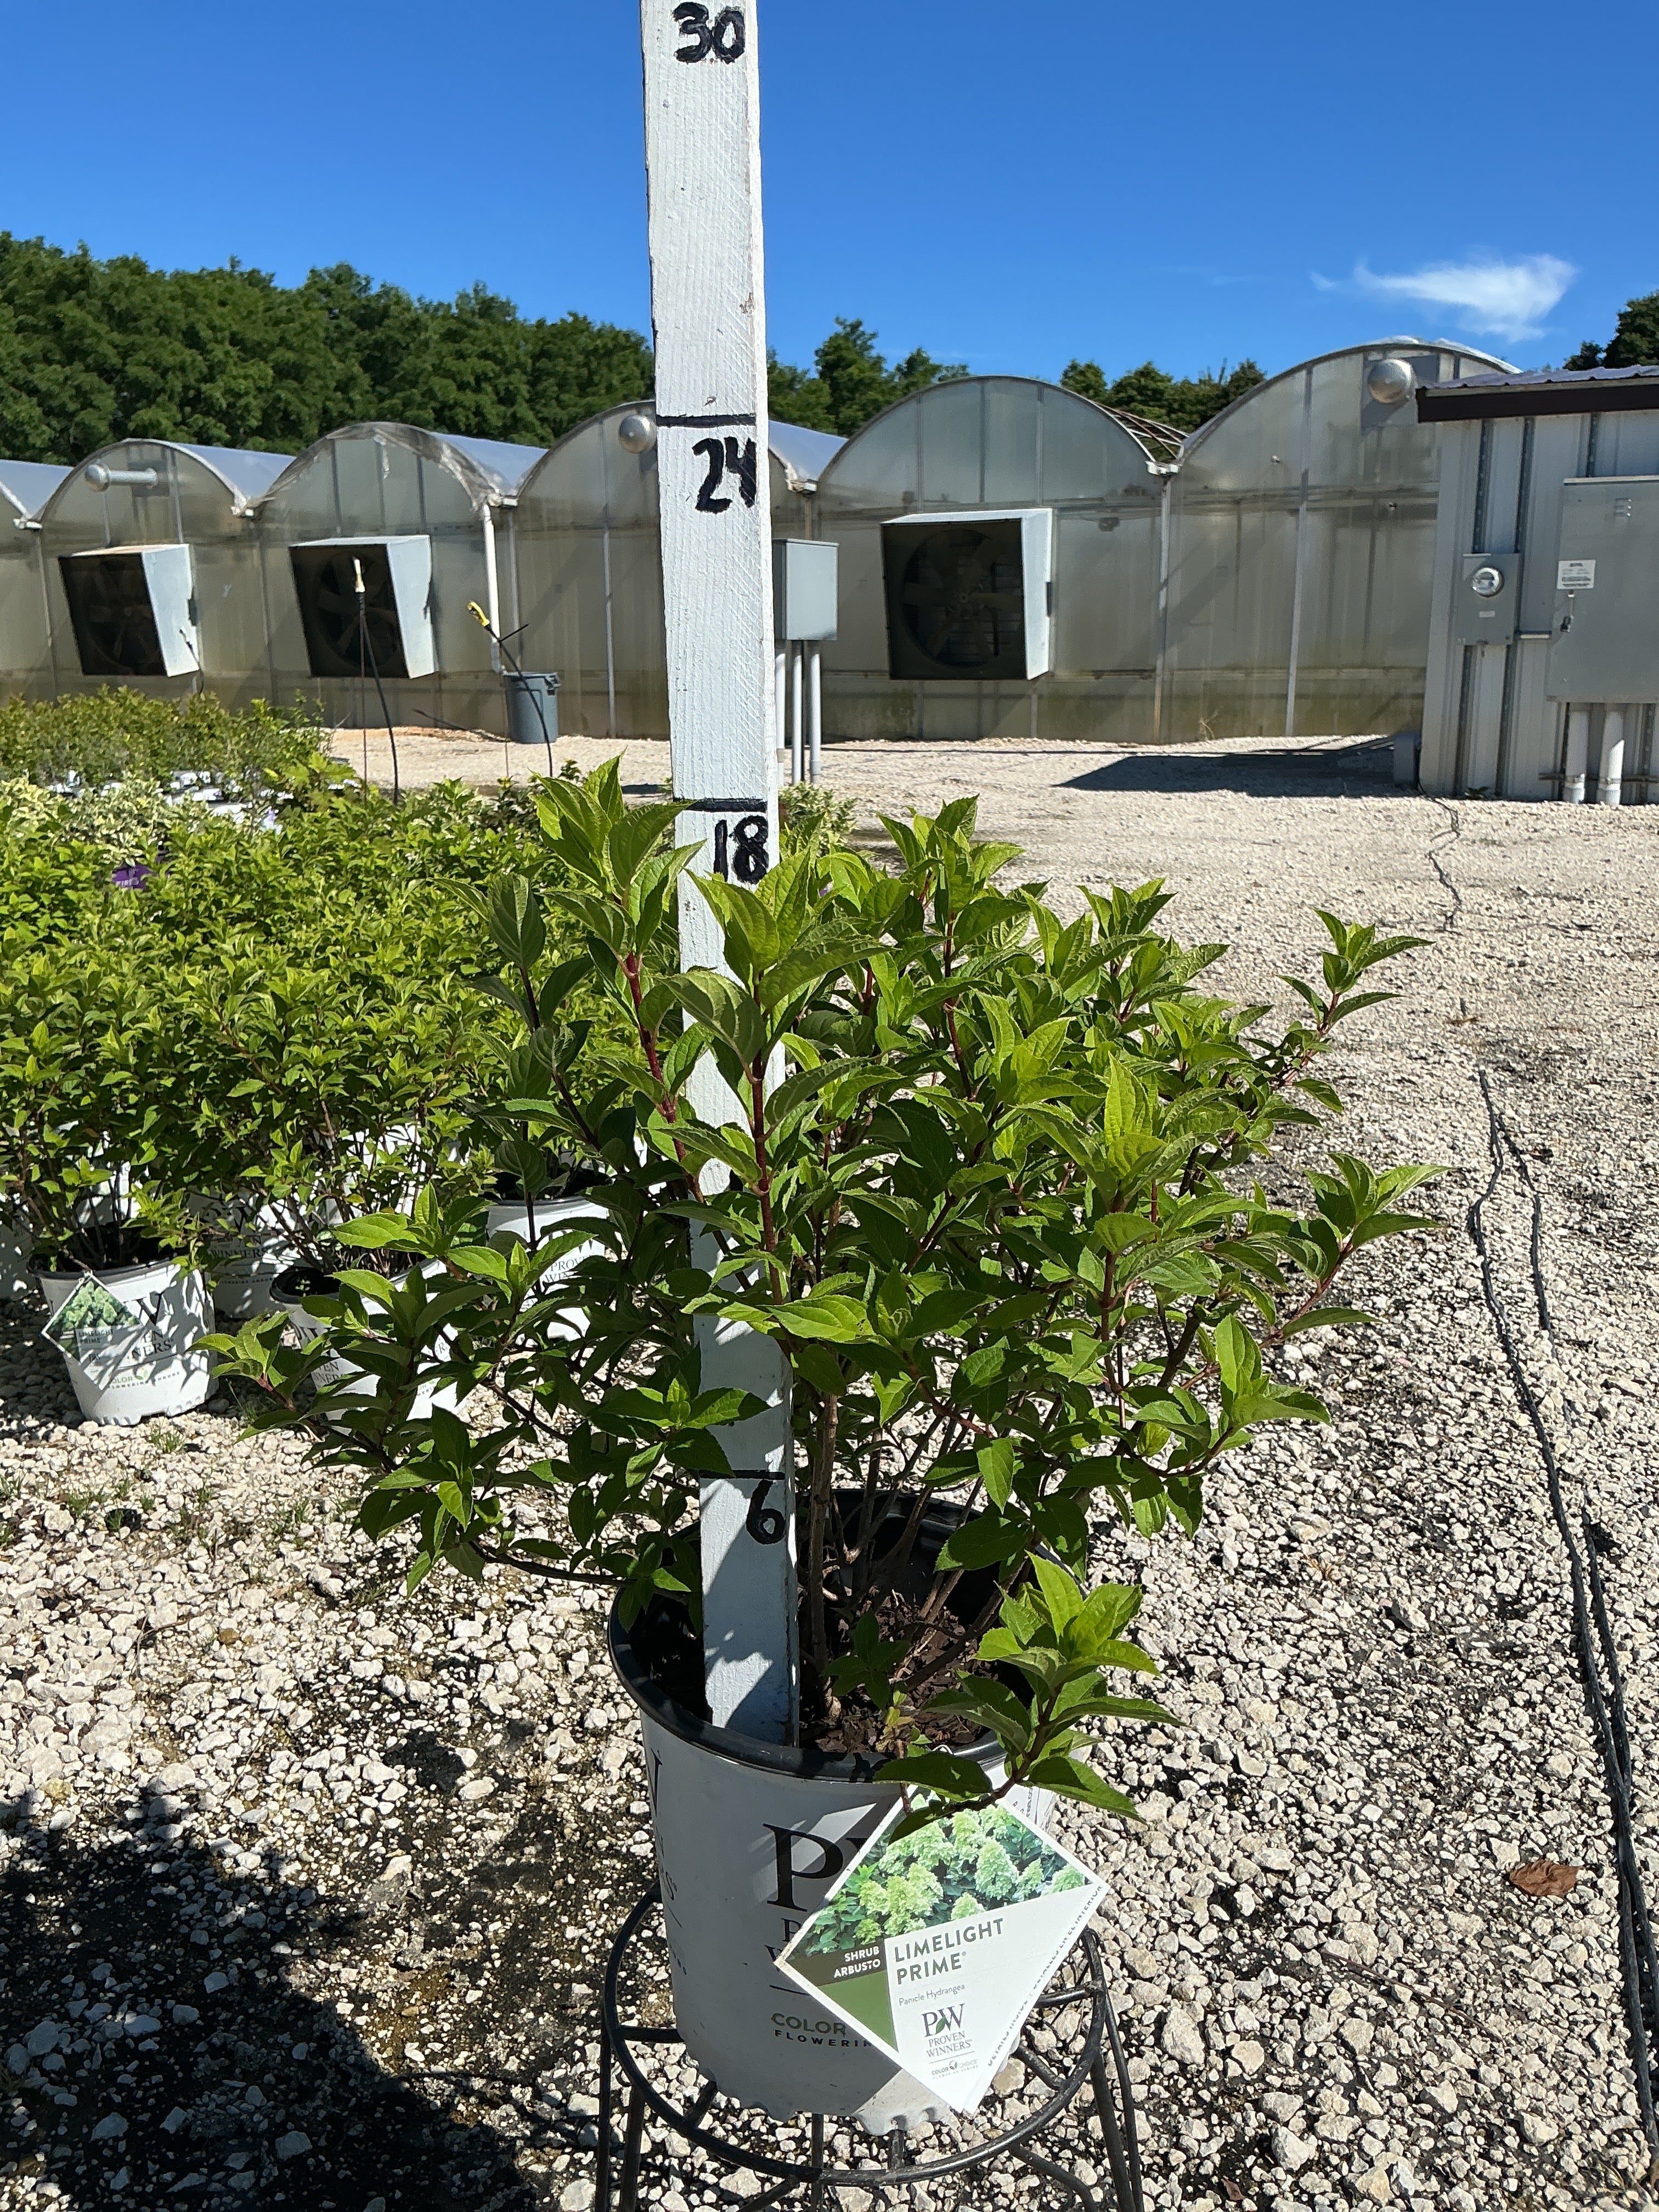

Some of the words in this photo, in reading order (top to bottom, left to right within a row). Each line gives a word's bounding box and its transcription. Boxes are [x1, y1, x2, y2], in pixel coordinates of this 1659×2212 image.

[672, 2, 745, 65] 30
[691, 436, 757, 515] 24
[714, 815, 769, 885] 18
[746, 1479, 786, 1545] 6
[894, 1918, 1003, 1962] LIMELIGHT
[844, 1946, 879, 1962] SHRUB
[834, 1959, 881, 1978] ARBUSTO
[899, 1994, 924, 2006] Panicle
[926, 1984, 966, 2000] Hydrangea
[771, 2013, 846, 2037] COLOR
[775, 2029, 873, 2047] FLOWERIN
[928, 2030, 966, 2047] PROVEN
